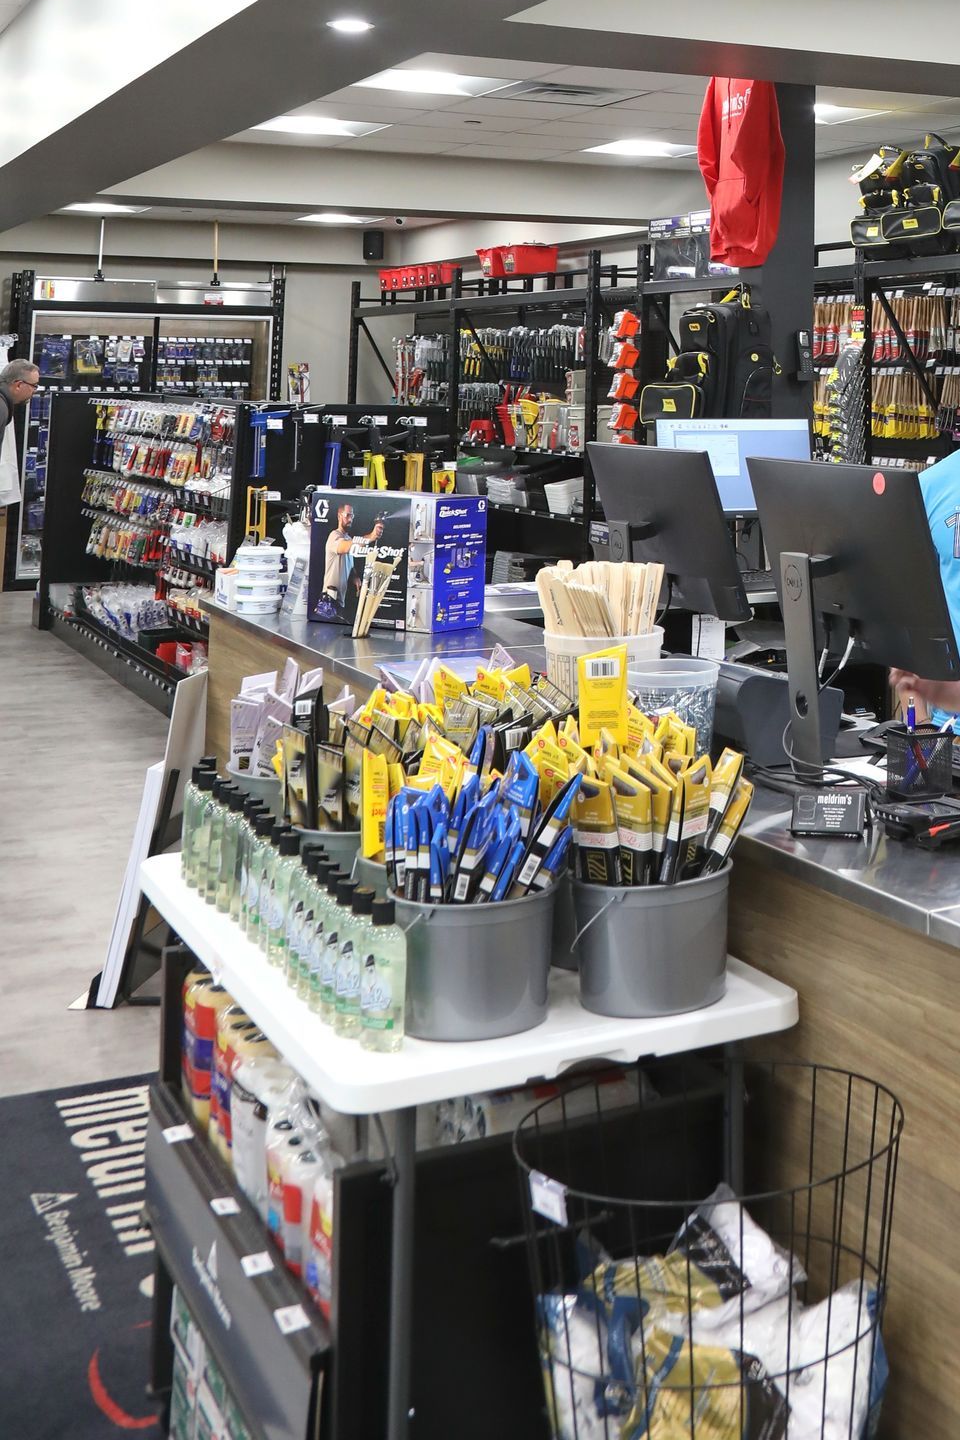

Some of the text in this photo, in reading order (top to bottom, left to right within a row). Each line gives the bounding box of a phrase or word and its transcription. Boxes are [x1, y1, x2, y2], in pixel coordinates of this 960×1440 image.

[352, 536, 370, 544] Ultra
[350, 546, 404, 559] QuickShot
[818, 794, 852, 805] meldrim's
[44, 1209, 102, 1312] Benjamin Moore
